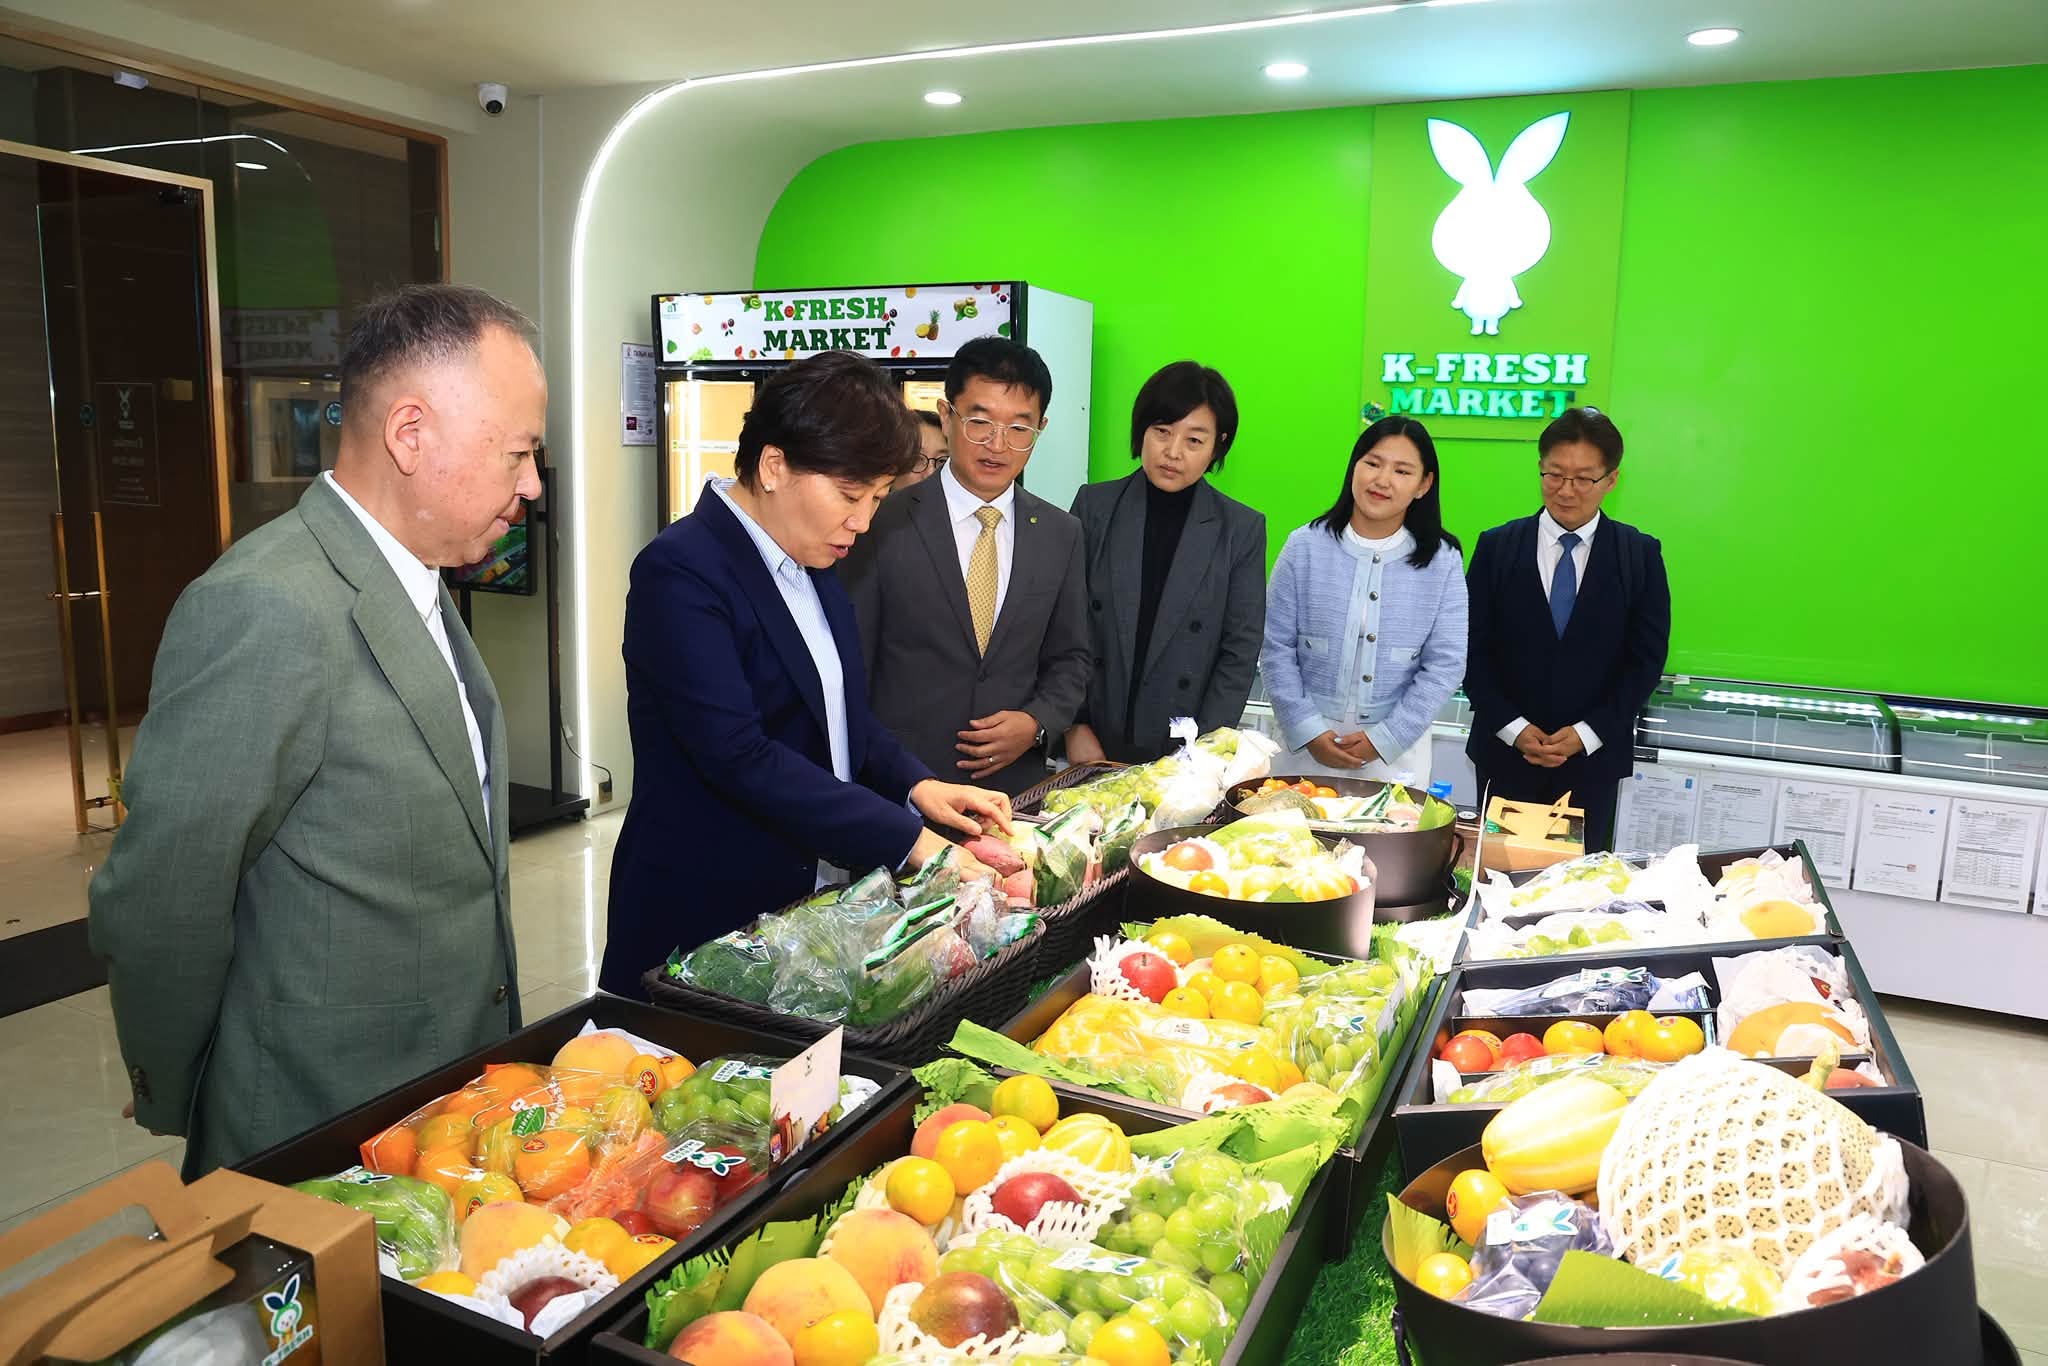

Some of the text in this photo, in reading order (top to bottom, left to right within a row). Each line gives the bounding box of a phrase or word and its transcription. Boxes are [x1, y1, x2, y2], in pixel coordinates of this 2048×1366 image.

[763, 327, 891, 351] MARKET
[1382, 353, 1588, 384] K-FRESH
[1390, 387, 1575, 418] MARKET
